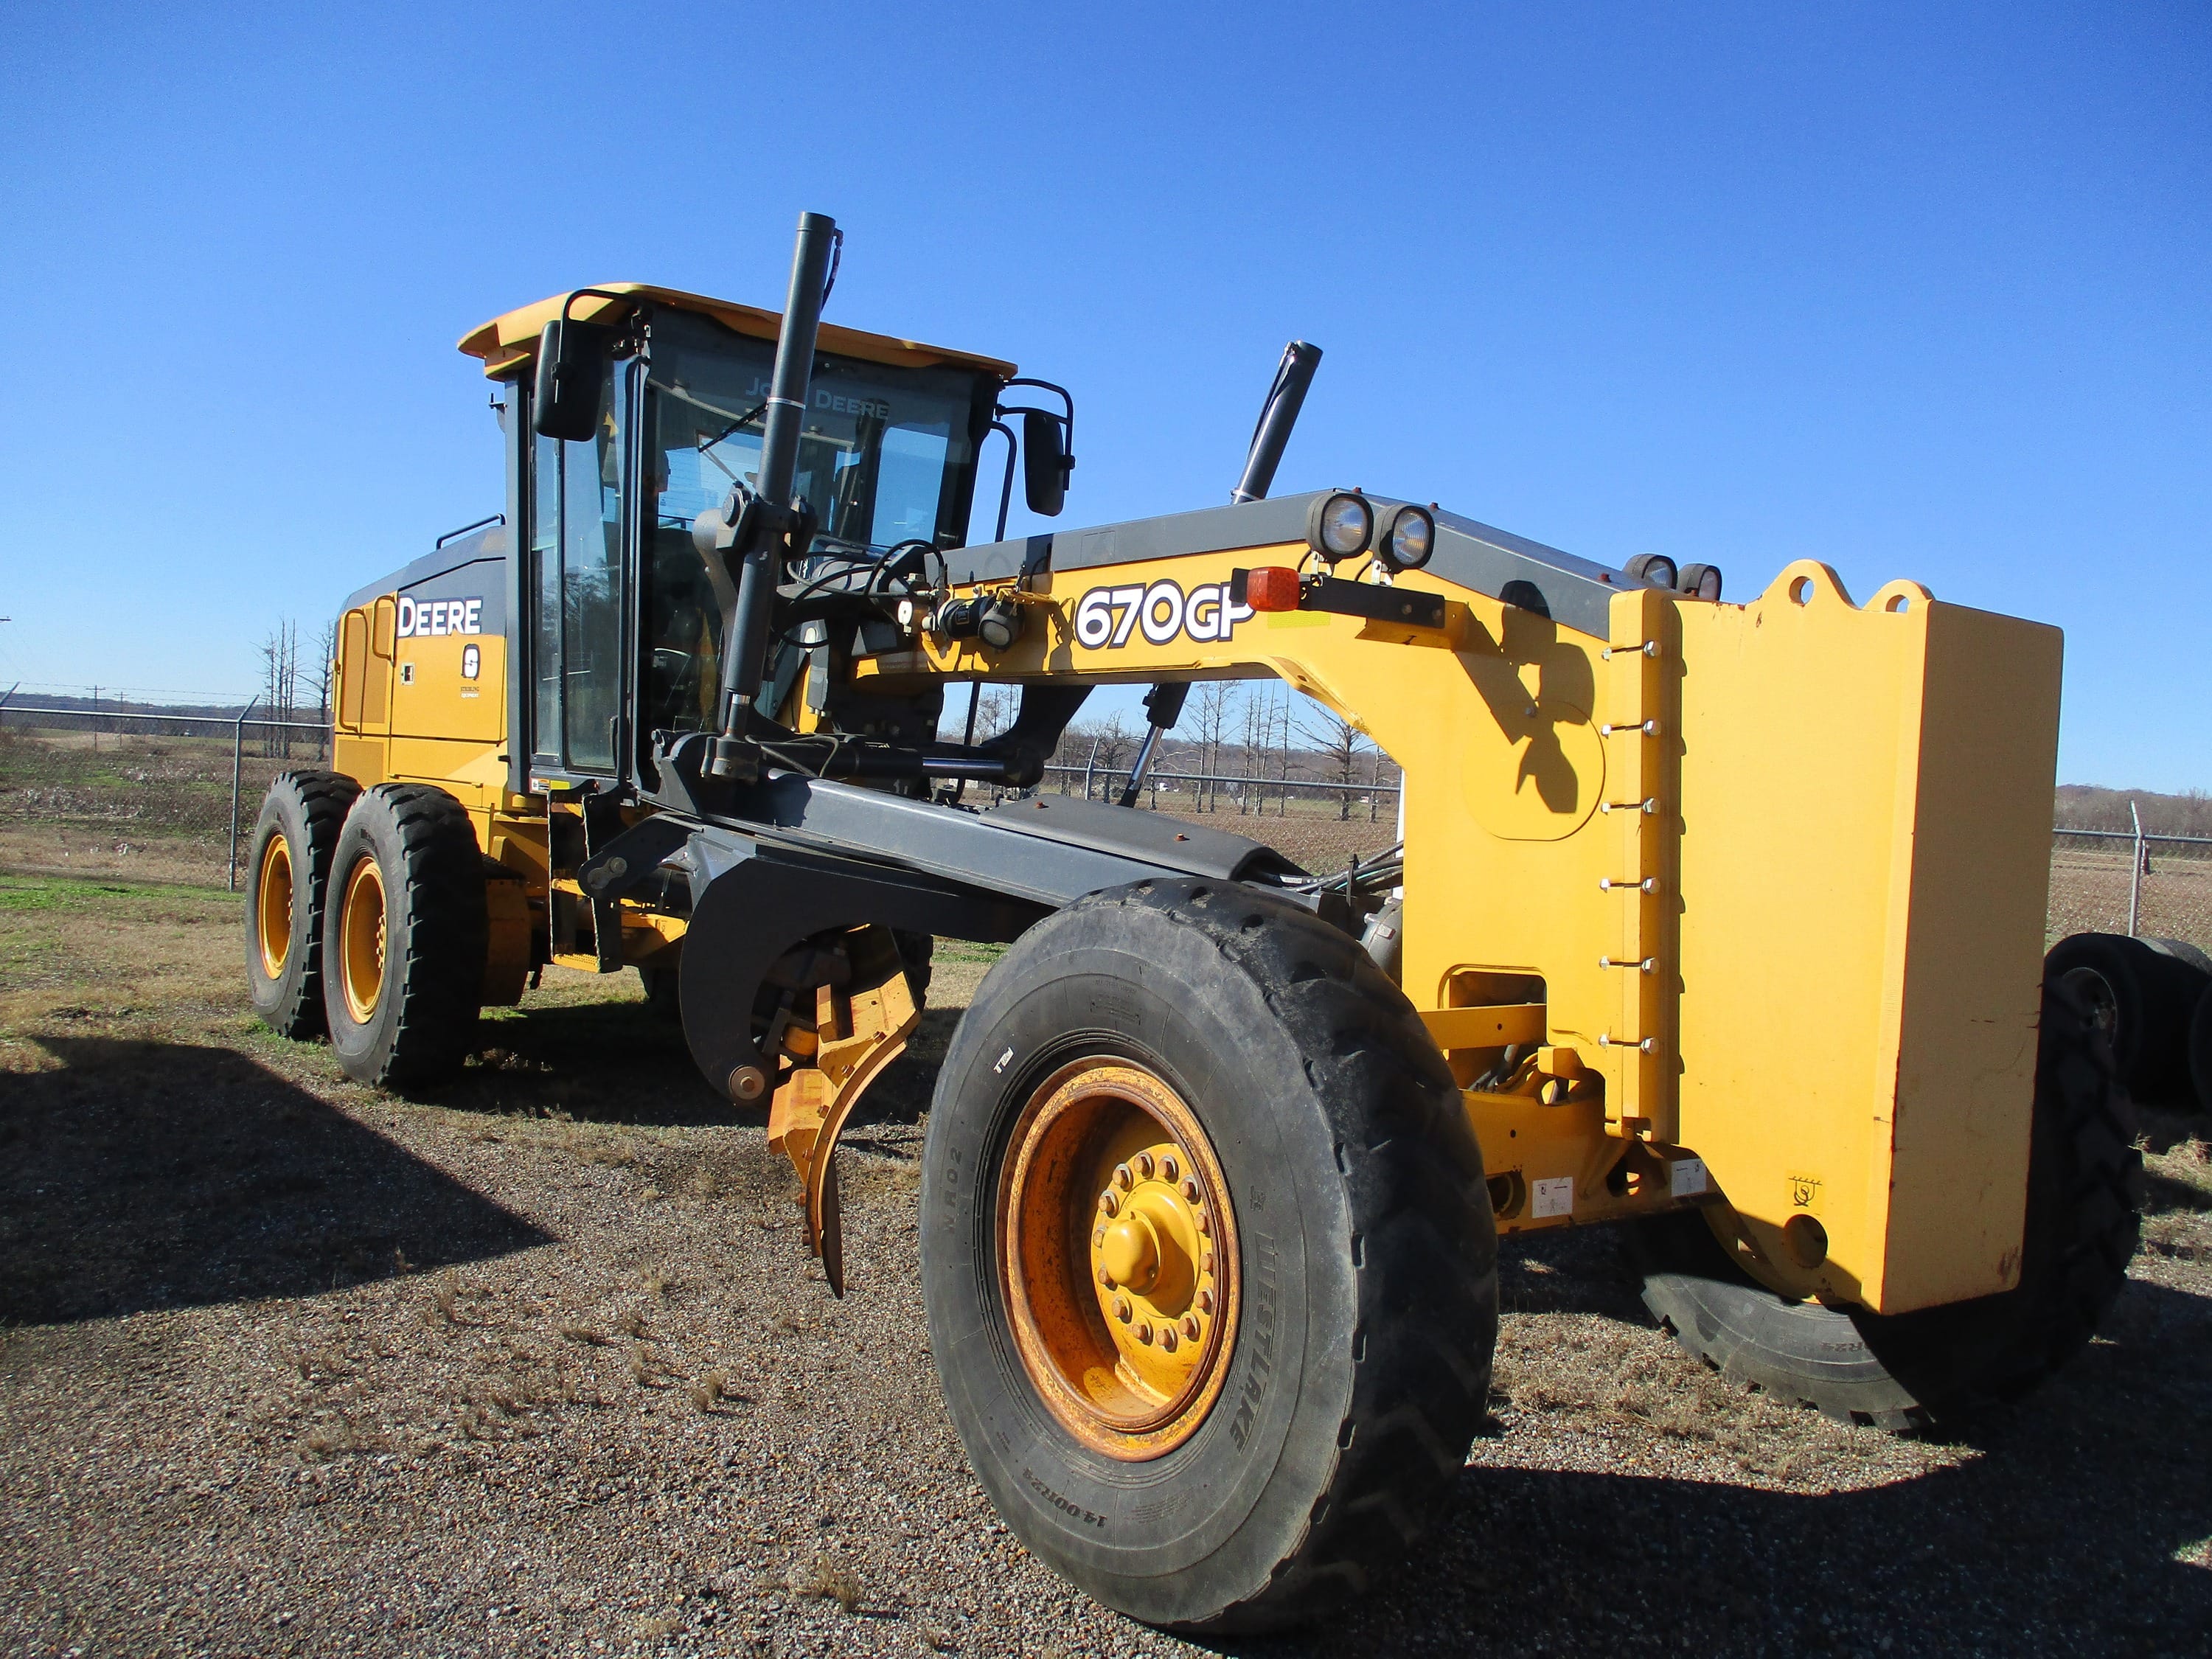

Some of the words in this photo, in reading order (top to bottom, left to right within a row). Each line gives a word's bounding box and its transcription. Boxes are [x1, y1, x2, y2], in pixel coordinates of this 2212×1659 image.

[815, 389, 889, 419] DEERE
[397, 594, 484, 639] DEERE
[1075, 578, 1256, 650] 670GP
[1228, 1231, 1276, 1456] WESTLAKE
